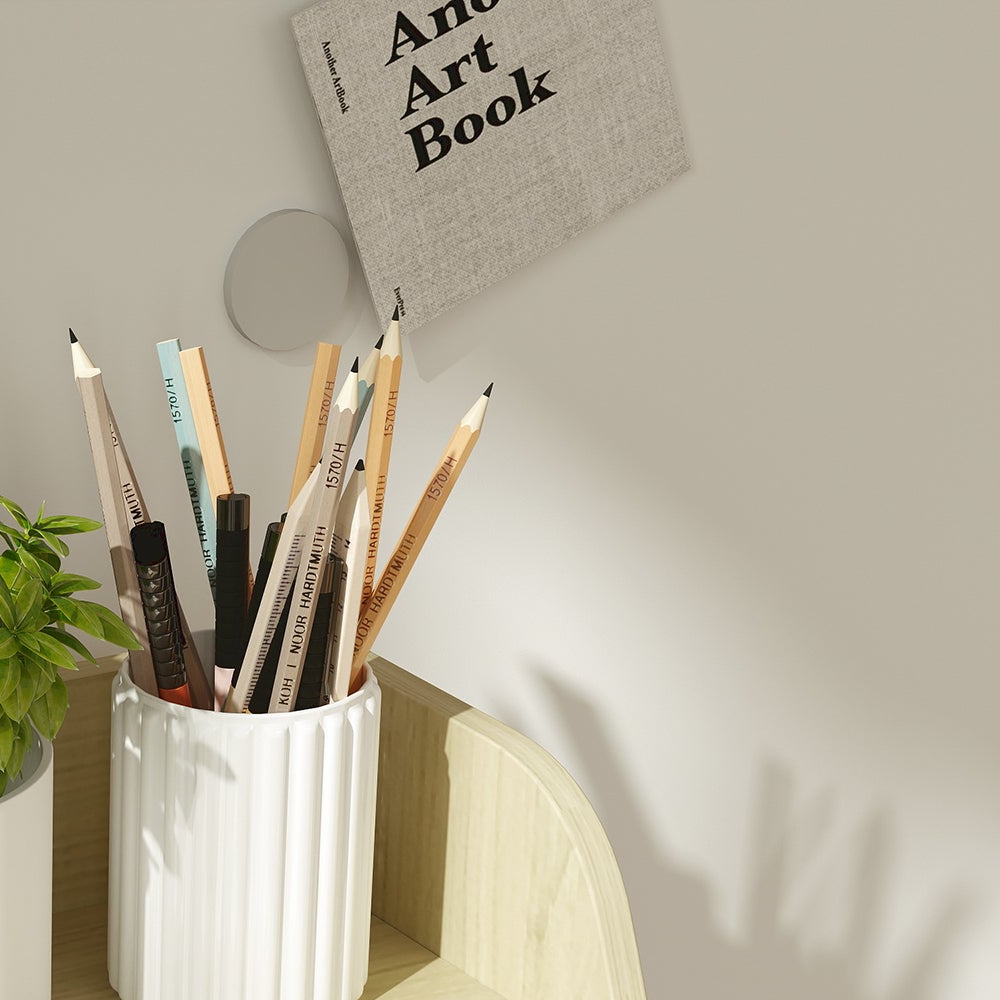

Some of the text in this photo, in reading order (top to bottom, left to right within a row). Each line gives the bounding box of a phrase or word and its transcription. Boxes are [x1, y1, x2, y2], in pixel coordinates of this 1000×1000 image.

[321, 41, 350, 115] Another ArtBook
[400, 33, 498, 121] Art
[404, 66, 558, 173] Book
[165, 377, 182, 424] 1570/H
[318, 380, 335, 427] 1570/H
[368, 474, 386, 559] HARDTMUTH
[384, 390, 398, 437] 1570/H
[279, 678, 293, 706] KOH
[290, 615, 307, 655] NOOR
[300, 526, 327, 608] HARDTMUTH
[325, 442, 347, 489] 1570/H
[370, 533, 416, 614] HARDTMUTH
[427, 455, 457, 501] 1570/H
